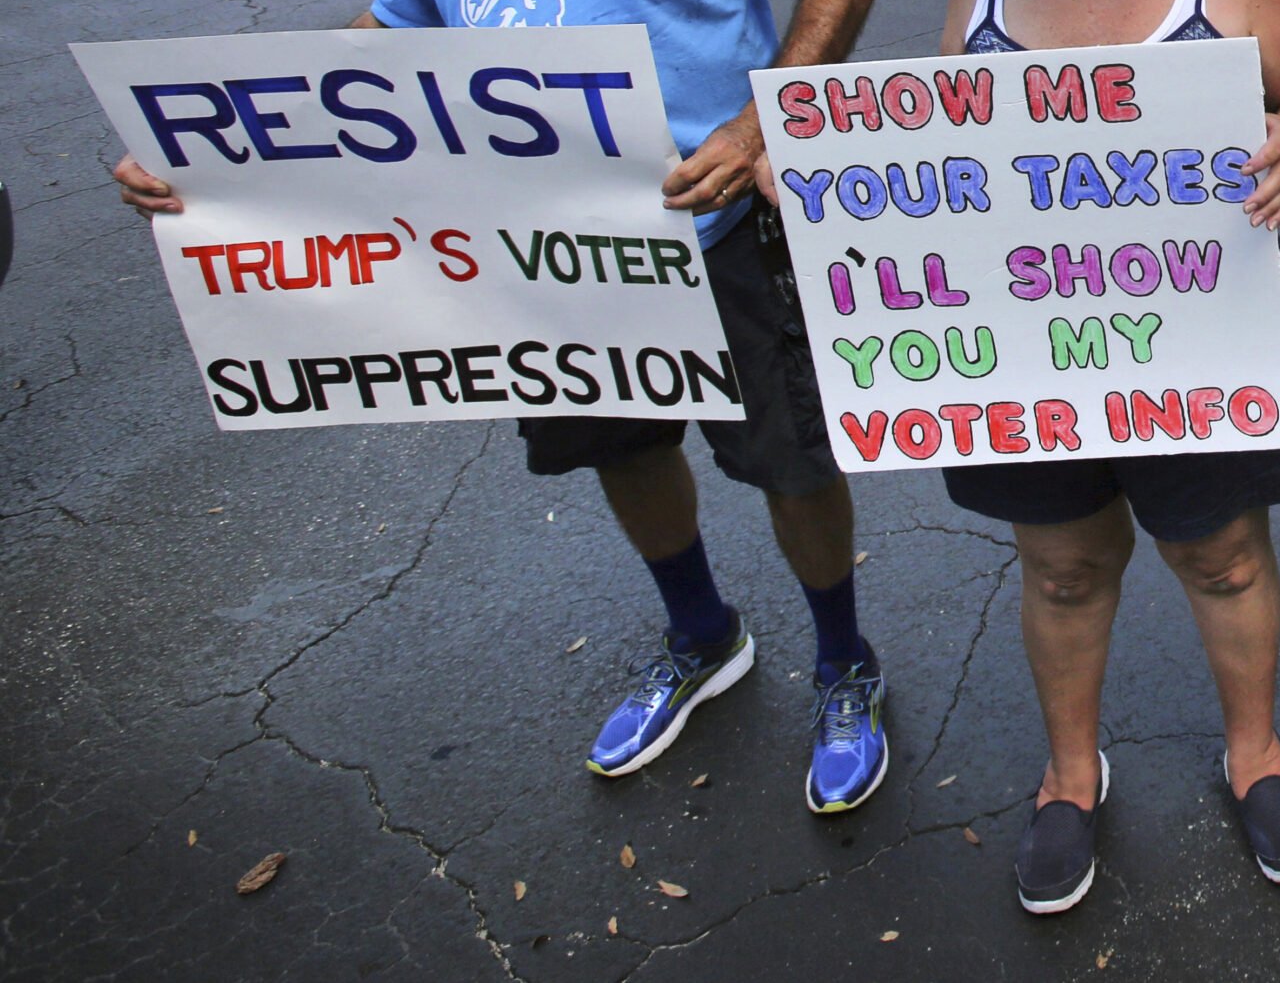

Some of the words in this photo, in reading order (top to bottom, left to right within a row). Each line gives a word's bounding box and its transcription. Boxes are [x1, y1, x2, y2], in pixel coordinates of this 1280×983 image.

[129, 68, 633, 167] RESIST
[778, 67, 993, 138] SHOW
[1024, 64, 1141, 123] ME
[781, 156, 991, 223] YOUR
[1012, 147, 1258, 211] TAXES
[181, 217, 479, 295] TRUMP'S
[497, 228, 700, 289] VOTER
[828, 246, 970, 315] I'LL
[1006, 239, 1222, 301] SHOW
[206, 340, 744, 417] SUPPRESSION
[833, 325, 997, 388] YOU
[1048, 313, 1163, 370] MY
[840, 399, 1081, 461] VOTER
[1105, 385, 1279, 443] INFO
